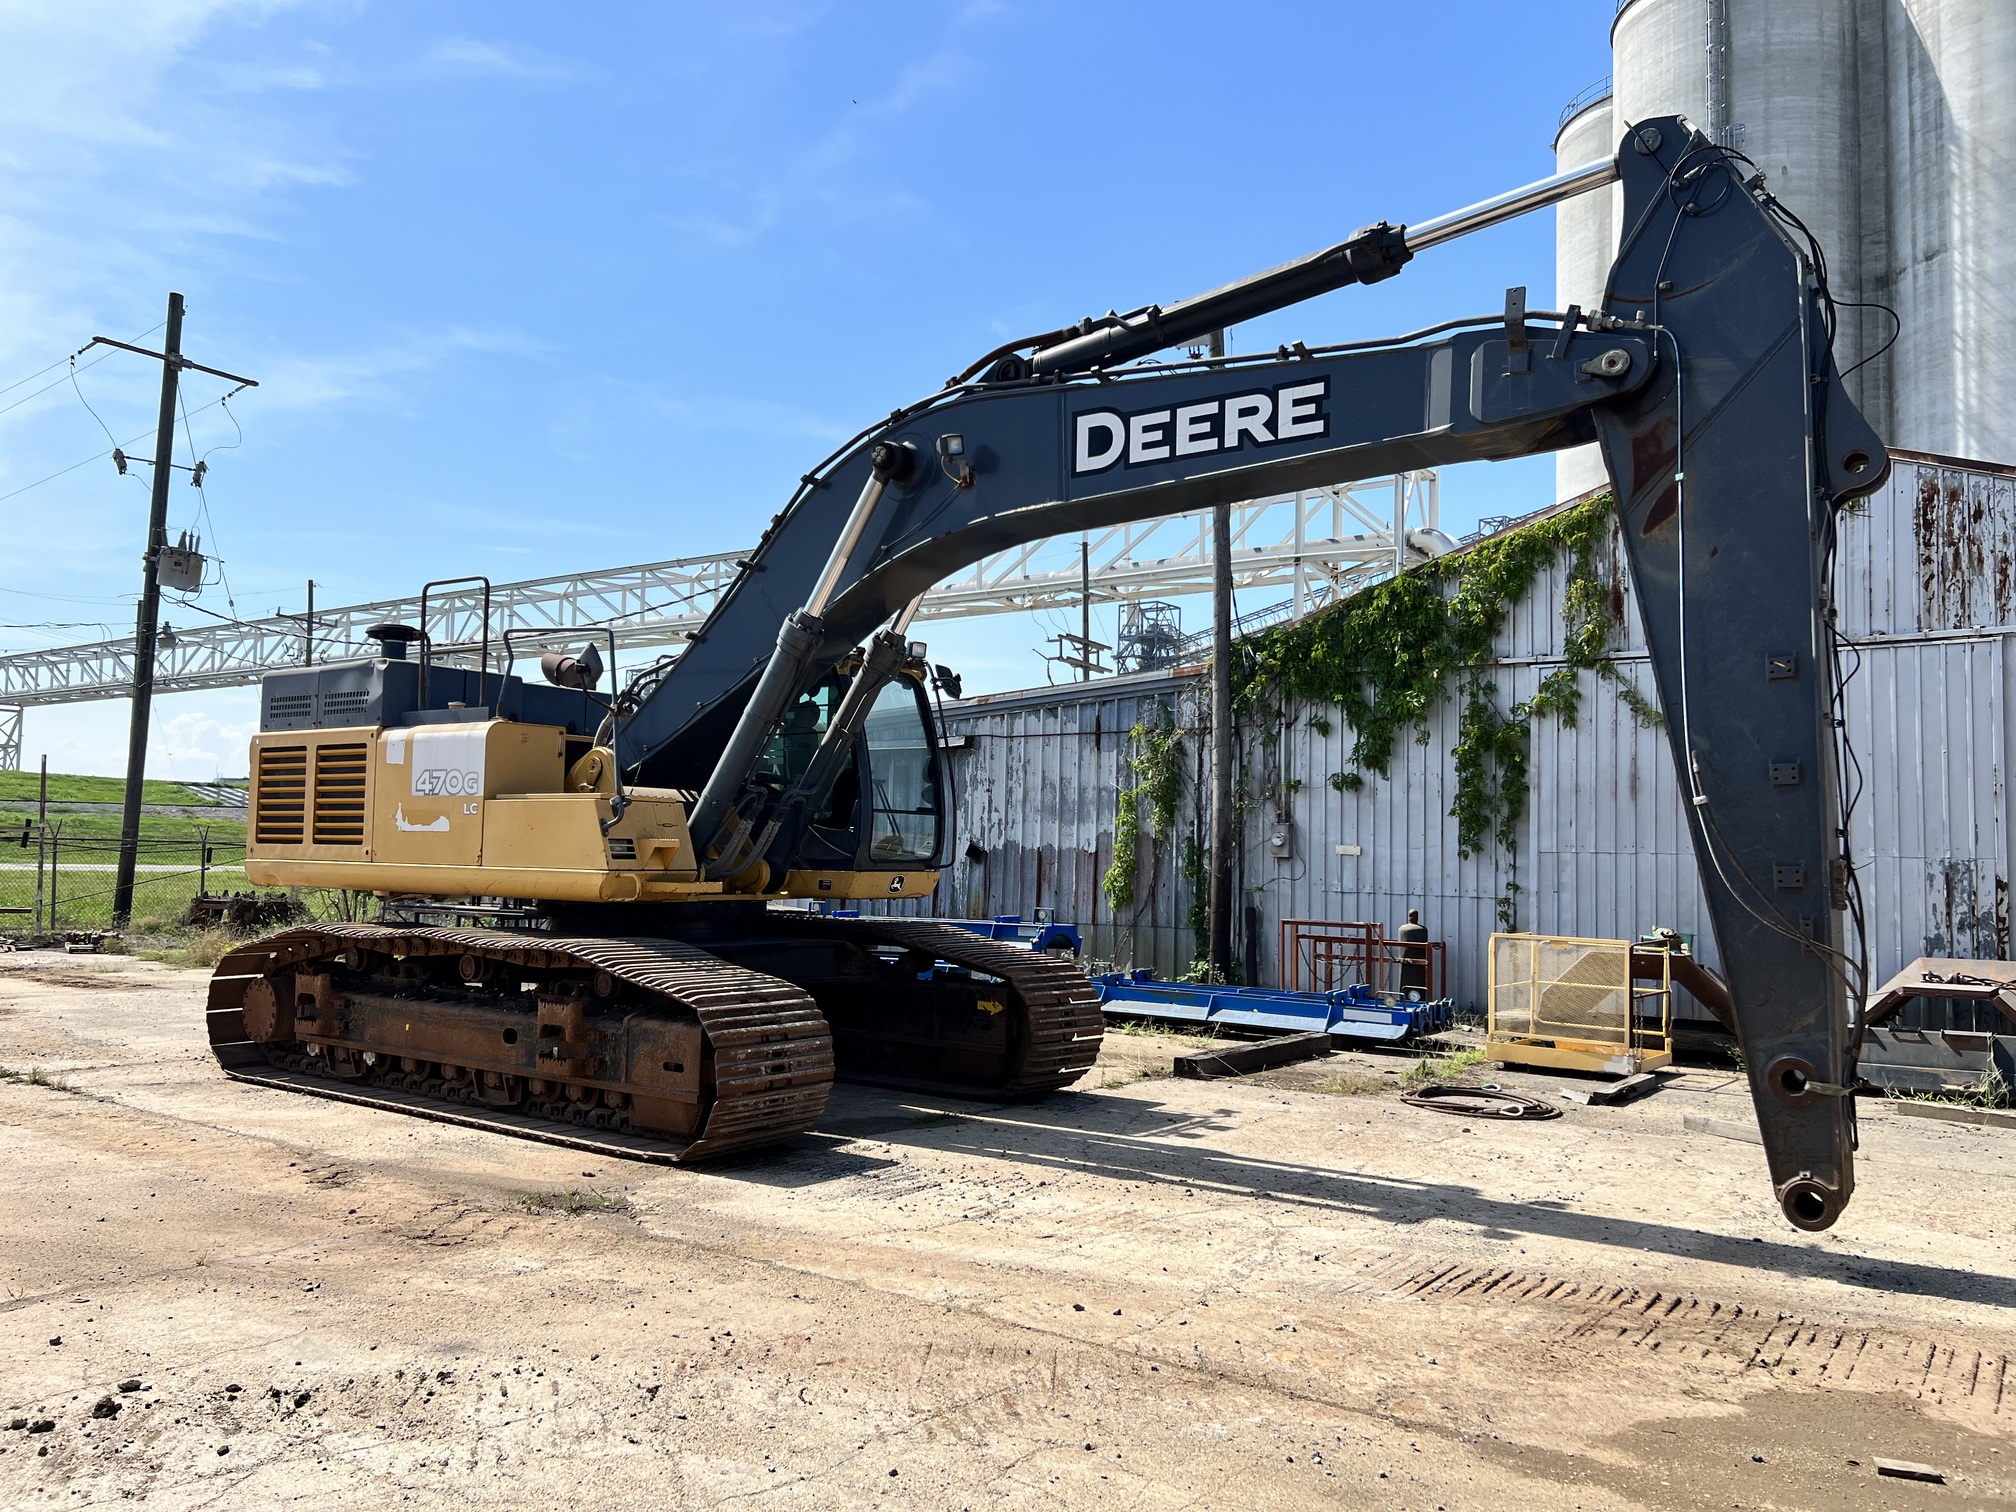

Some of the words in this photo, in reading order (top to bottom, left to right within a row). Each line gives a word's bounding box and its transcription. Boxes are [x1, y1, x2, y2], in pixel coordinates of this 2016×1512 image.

[1076, 382, 1325, 473] DEERE
[415, 768, 479, 796] 470G
[463, 802, 478, 815] LC
